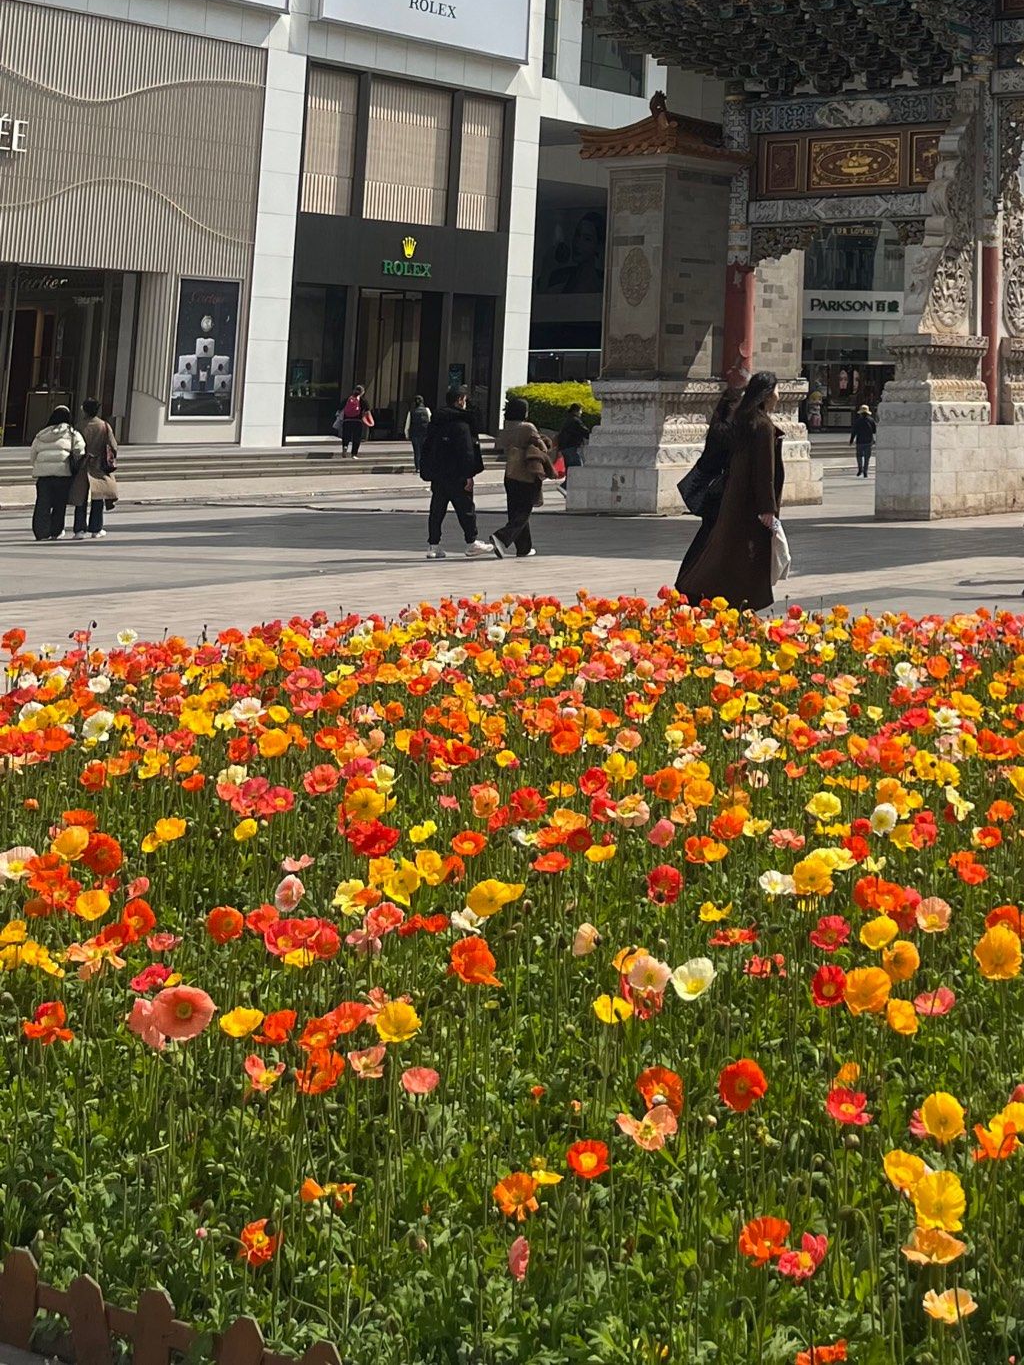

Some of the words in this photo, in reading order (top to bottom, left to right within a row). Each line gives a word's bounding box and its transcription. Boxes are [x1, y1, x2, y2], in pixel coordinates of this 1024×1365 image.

[382, 259, 432, 277] ROLEX
[810, 298, 873, 312] PARKSON
[875, 300, 899, 313] 百盛
